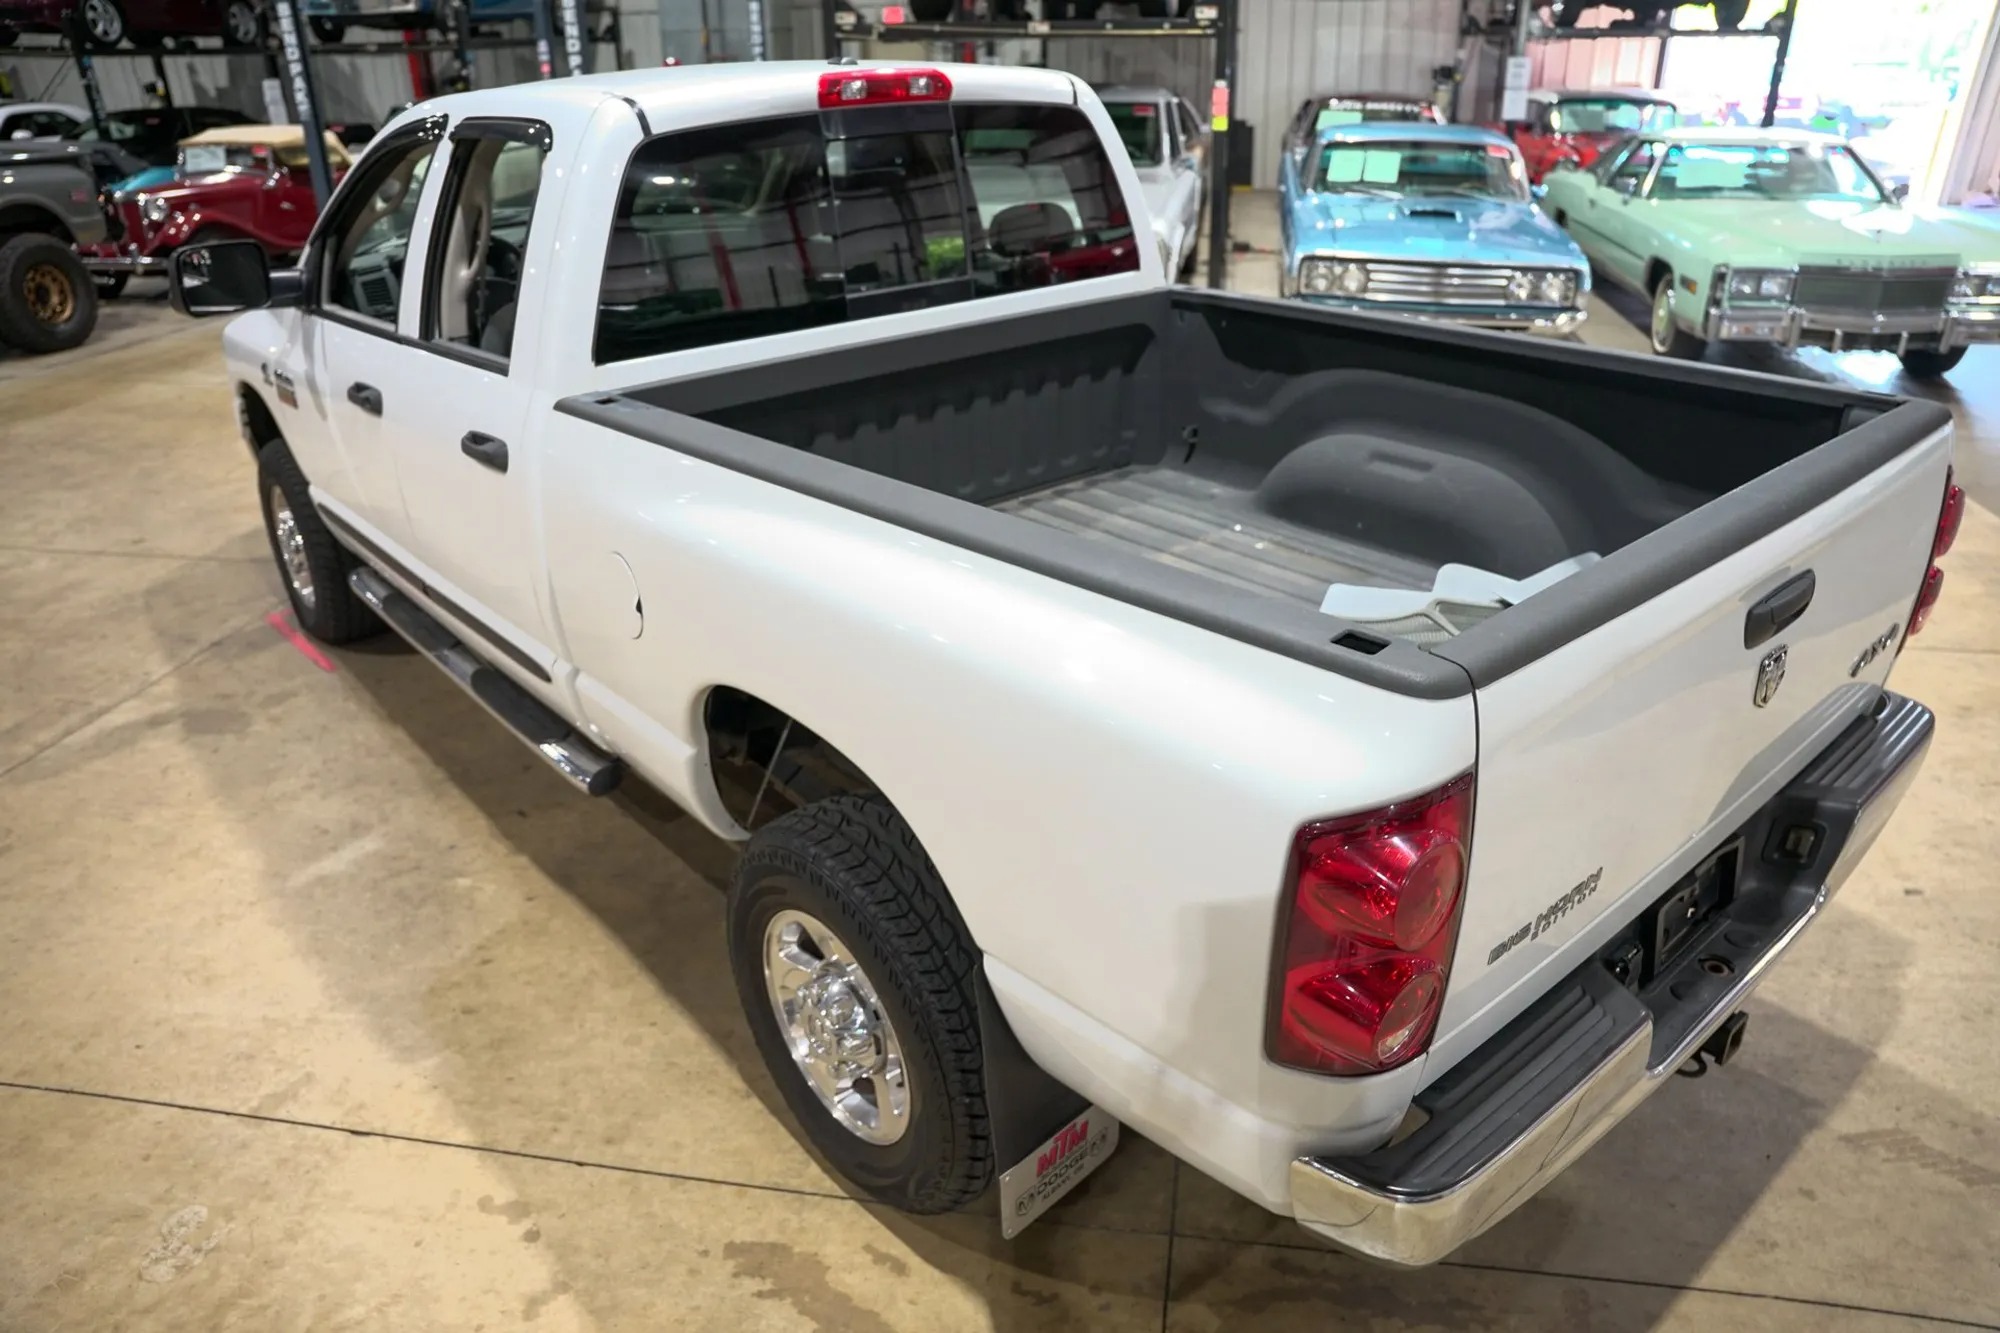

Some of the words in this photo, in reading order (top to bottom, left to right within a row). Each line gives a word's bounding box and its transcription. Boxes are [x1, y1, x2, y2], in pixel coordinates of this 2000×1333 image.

[1487, 921, 1532, 965] BIG
[1534, 866, 1603, 931] HORN
[1531, 883, 1598, 941] EDITION
[1037, 1145, 1088, 1195] DODGE
